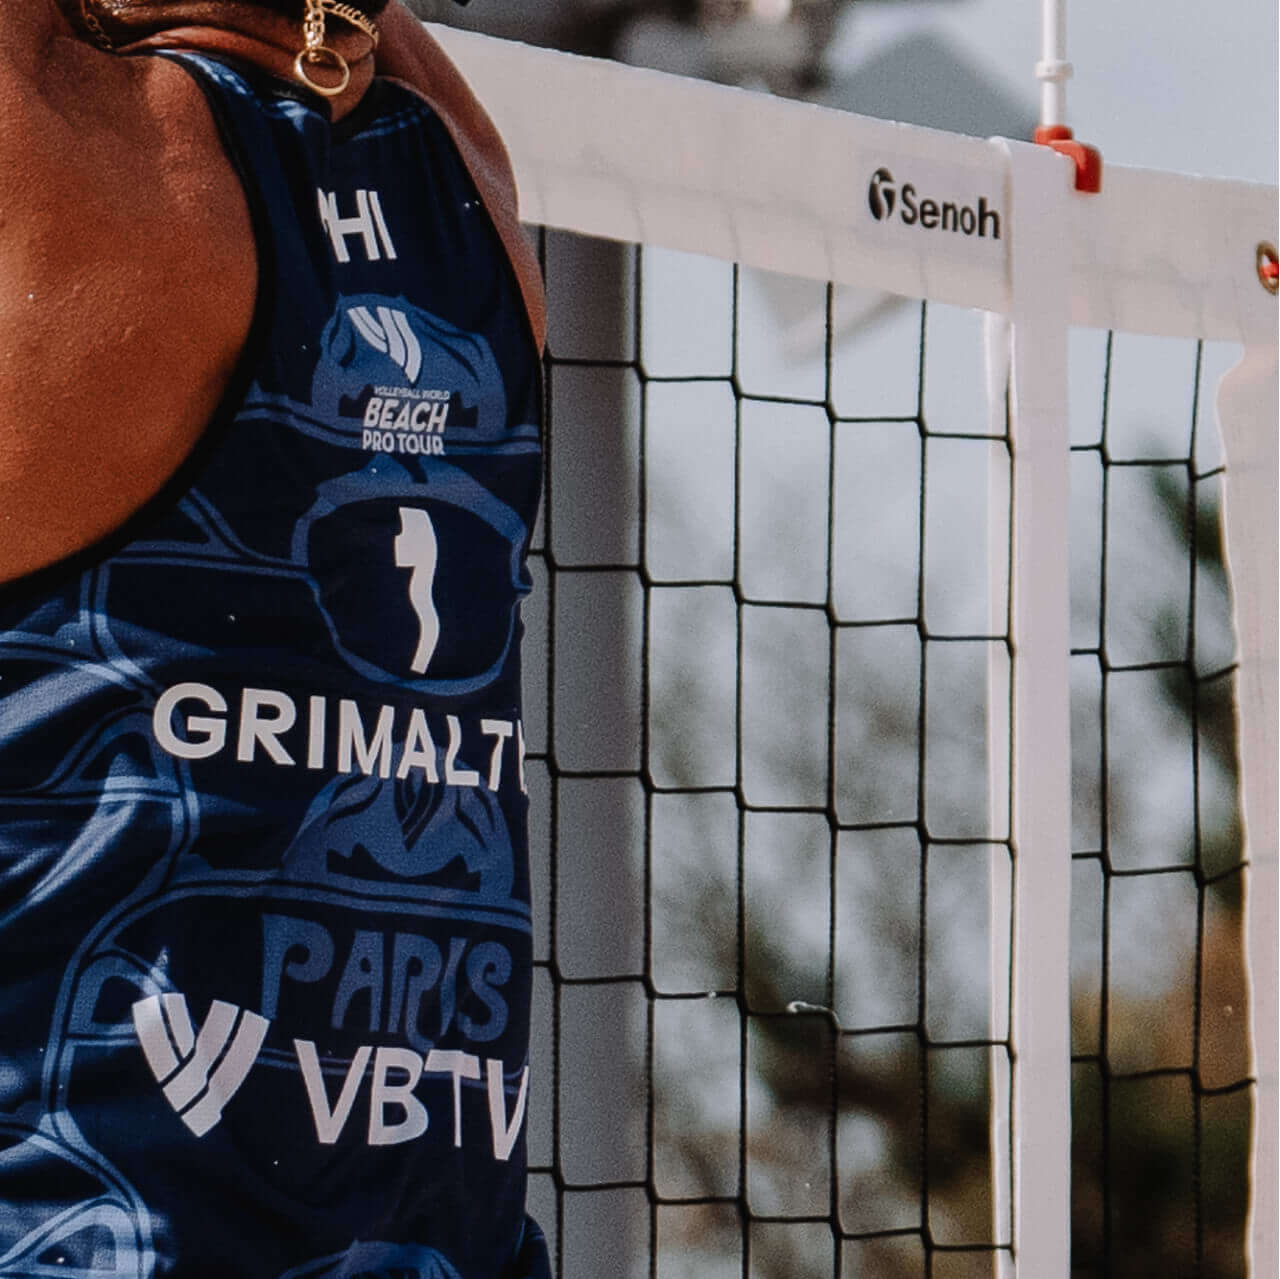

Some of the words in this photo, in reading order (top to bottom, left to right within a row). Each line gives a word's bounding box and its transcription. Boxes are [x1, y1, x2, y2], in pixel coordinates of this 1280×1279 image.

[317, 187, 397, 263] HI
[901, 184, 1001, 240] Senoh
[362, 429, 395, 453] PRO
[396, 433, 446, 456] TOUR
[363, 397, 449, 433] BEACH
[395, 506, 438, 676] 1
[153, 682, 528, 795] GRIMALT
[260, 912, 513, 1053] PARIS
[293, 1038, 530, 1161] VBTV
